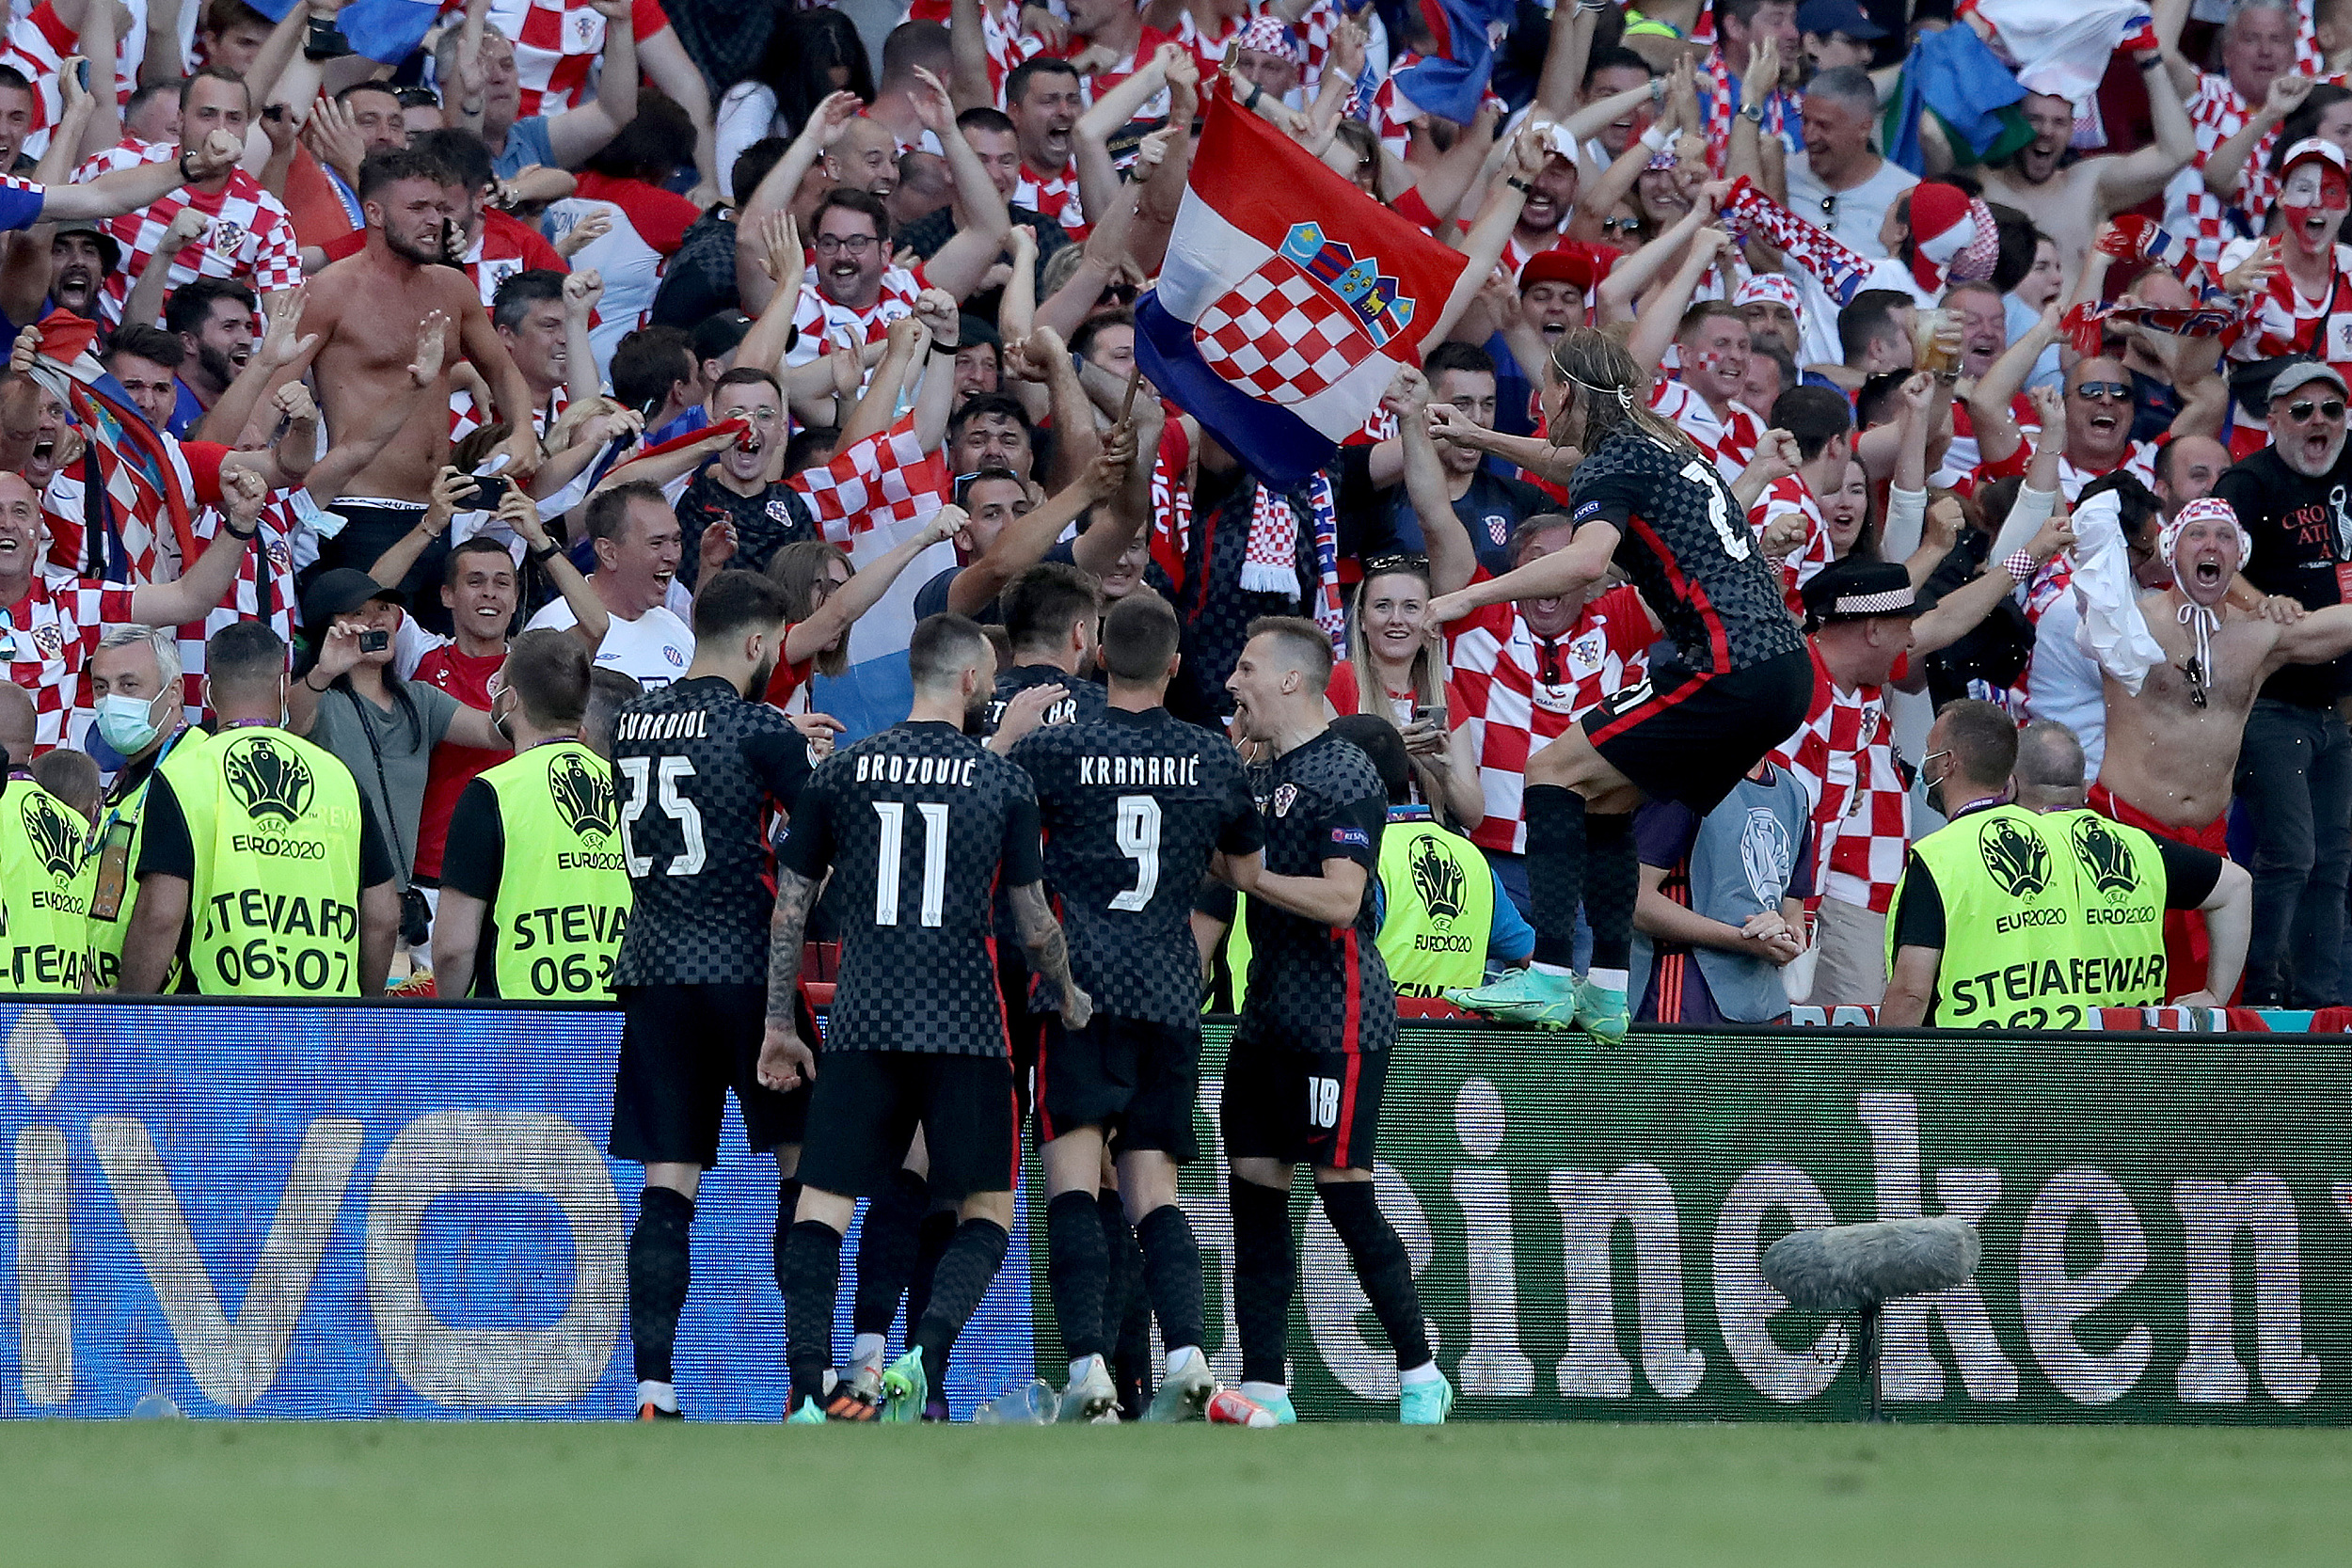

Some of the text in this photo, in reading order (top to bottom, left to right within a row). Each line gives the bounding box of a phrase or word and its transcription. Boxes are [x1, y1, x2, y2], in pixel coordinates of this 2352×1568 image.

[1679, 460, 1752, 562] 2
[2282, 505, 2325, 530] CRO
[2297, 524, 2330, 545] ATI
[2318, 543, 2333, 560] A
[1080, 753, 1200, 786] KRAMARIĆ
[259, 821, 287, 835] UEFA
[617, 755, 707, 878] 25
[232, 834, 326, 860] EURO2020
[558, 852, 626, 870] EURO202
[1107, 795, 1162, 912] 9
[871, 801, 949, 927] 11
[514, 904, 629, 951] STEA
[1996, 908, 2067, 934] EUR2020
[1309, 1077, 1341, 1129] 18
[7, 1008, 628, 1409] ivo
